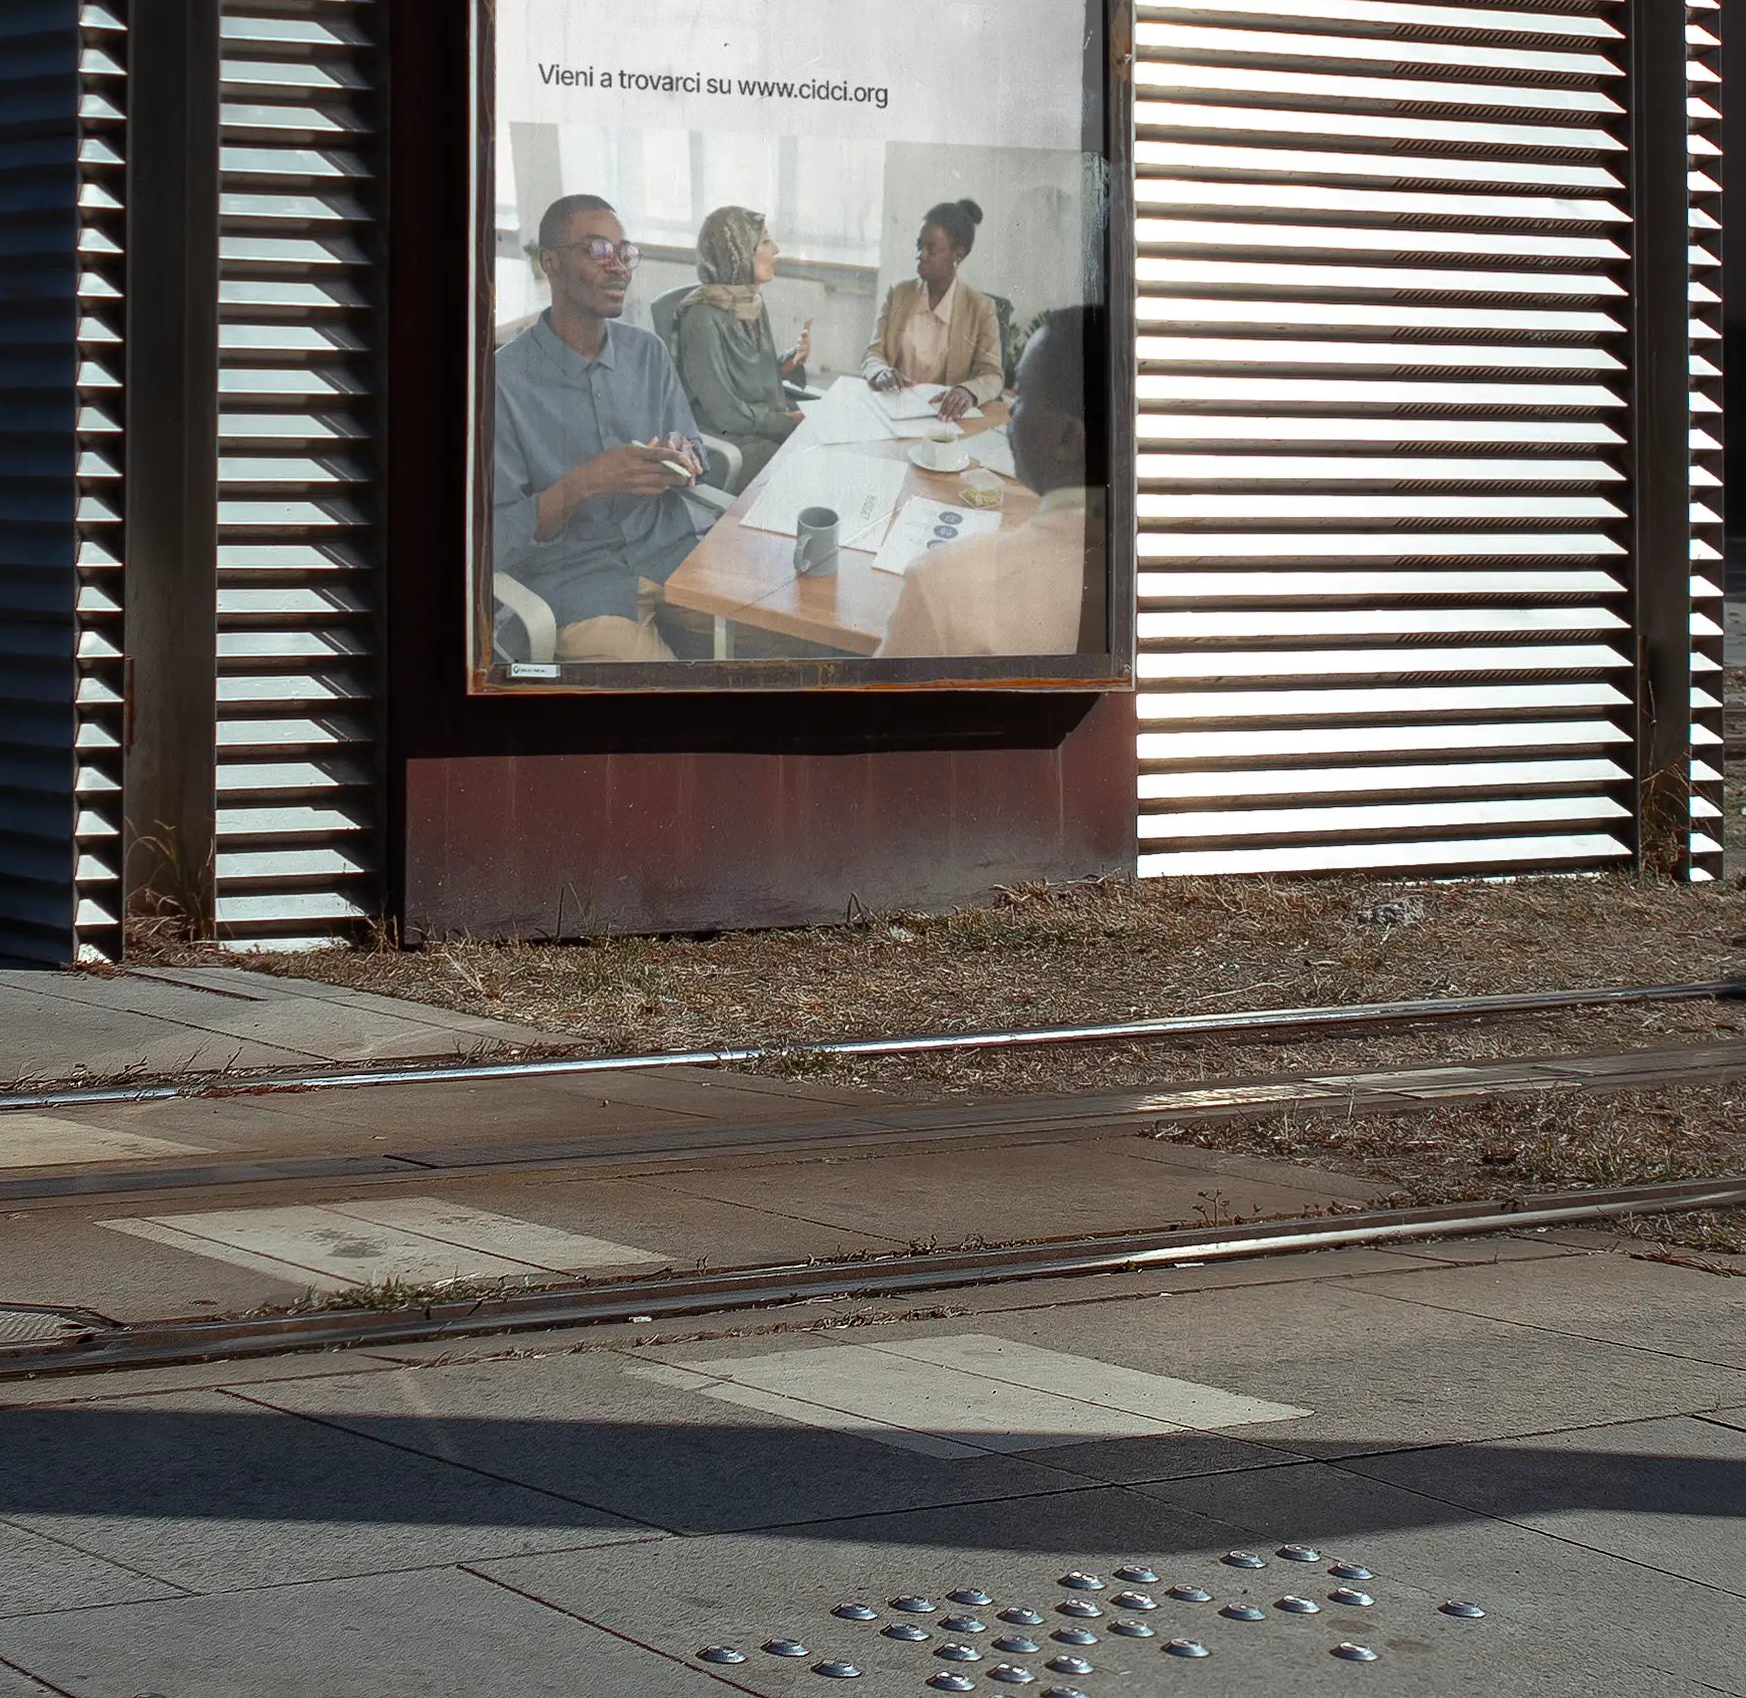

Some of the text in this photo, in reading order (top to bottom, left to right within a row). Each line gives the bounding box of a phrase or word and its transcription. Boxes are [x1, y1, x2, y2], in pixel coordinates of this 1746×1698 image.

[538, 63, 888, 109] Vieni a trovarci su www.cidci.org
